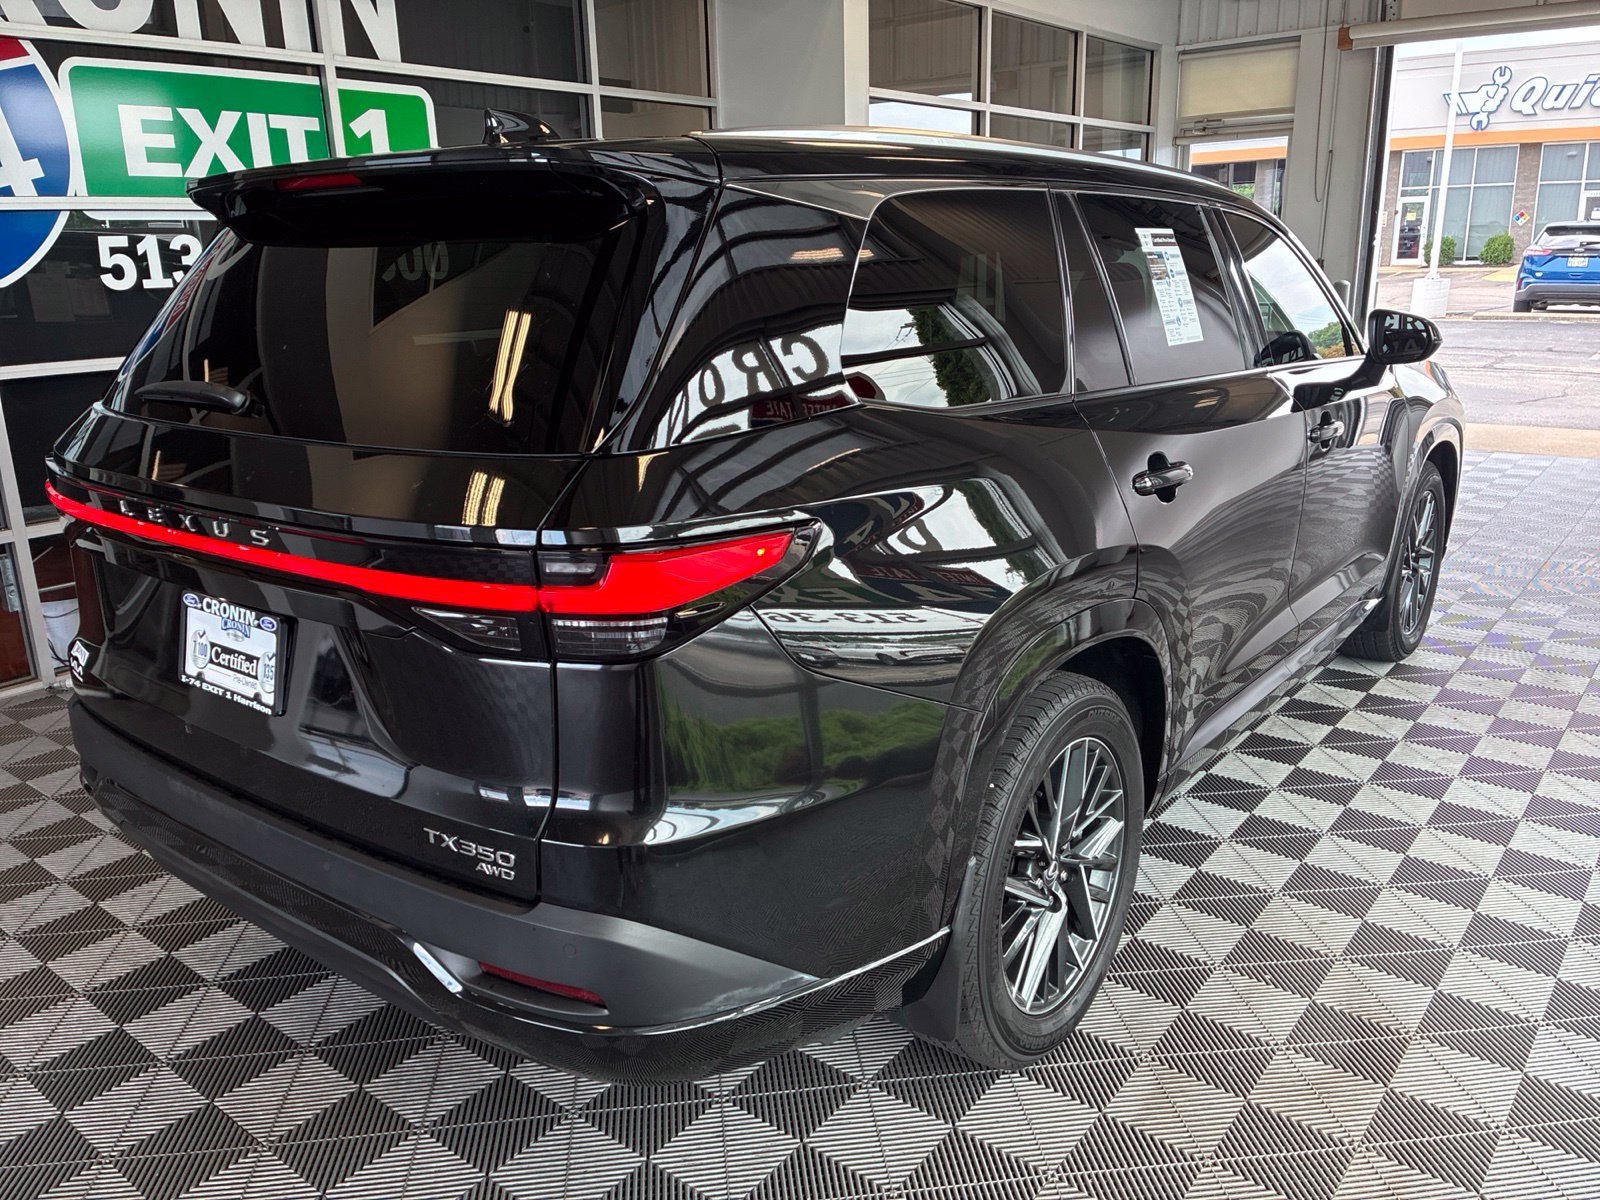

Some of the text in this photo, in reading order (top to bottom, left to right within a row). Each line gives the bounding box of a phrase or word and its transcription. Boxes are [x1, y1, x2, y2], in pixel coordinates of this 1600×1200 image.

[118, 104, 391, 178] EXIT 1
[119, 500, 270, 546] LEXUS
[202, 597, 256, 626] CRONIN
[211, 646, 258, 676] Certified
[202, 682, 225, 697] EXIT
[225, 691, 232, 700] 1
[233, 693, 272, 715] Harrison
[423, 827, 516, 868] TX350
[475, 862, 516, 881] AWD
